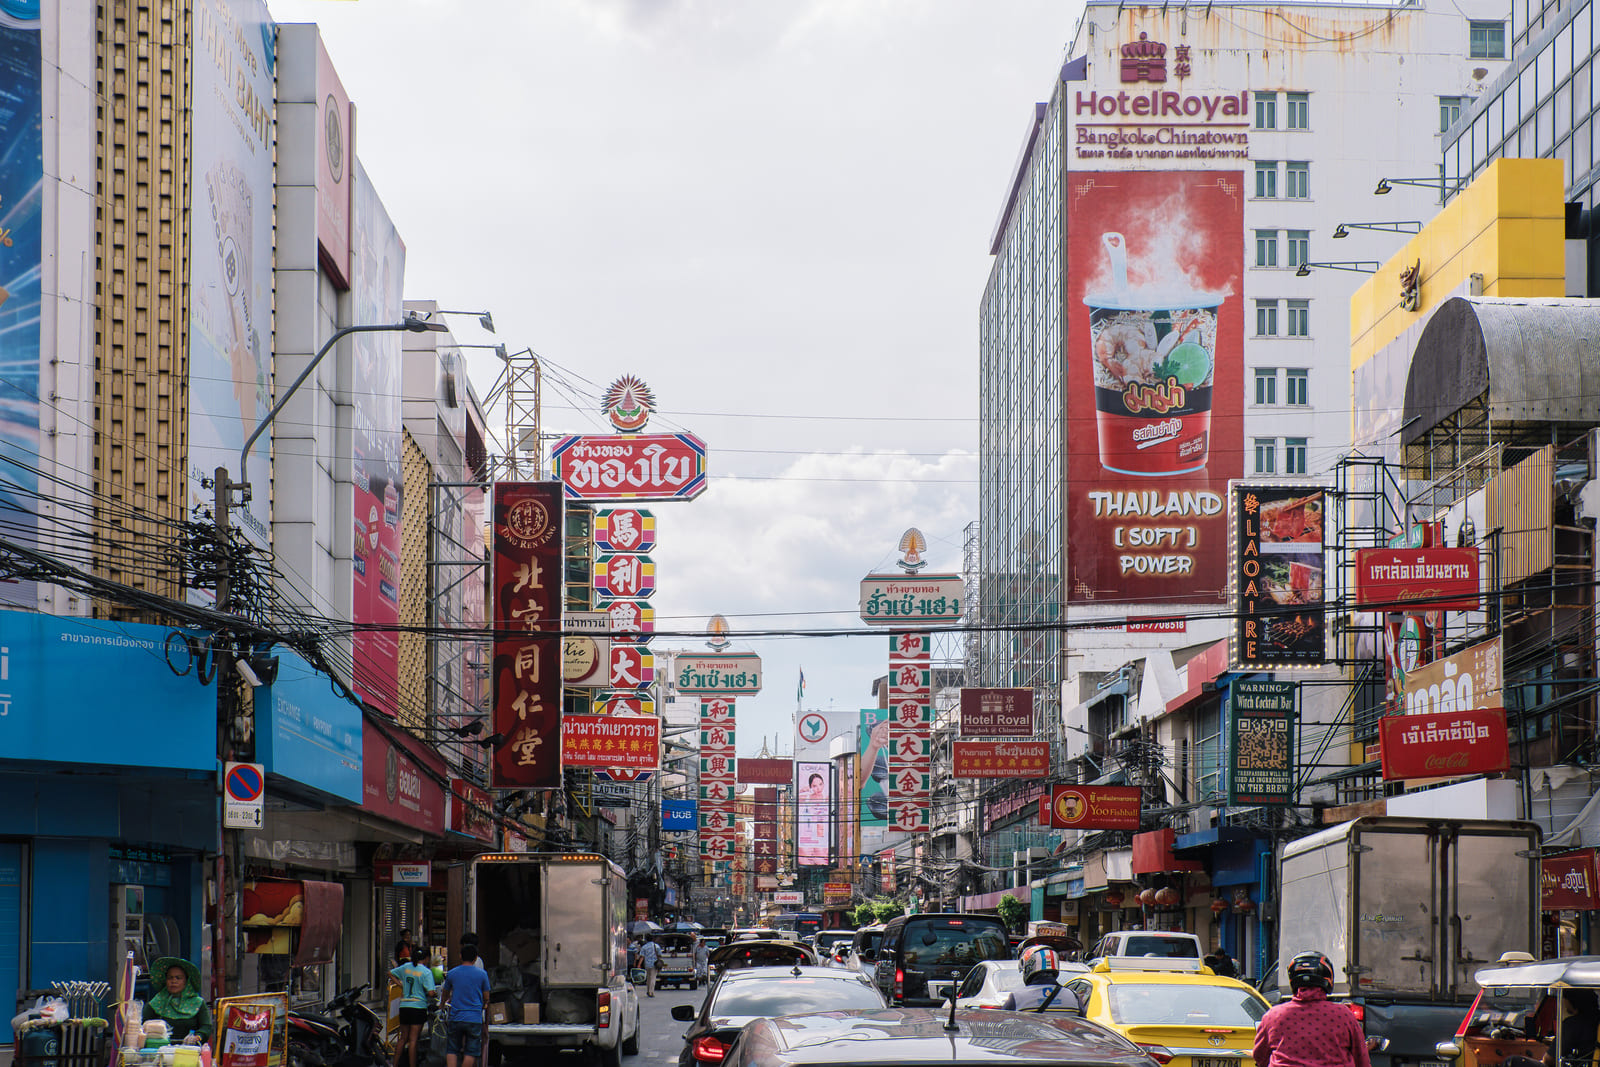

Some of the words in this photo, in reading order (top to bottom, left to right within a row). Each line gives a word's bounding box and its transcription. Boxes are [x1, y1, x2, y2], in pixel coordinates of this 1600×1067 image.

[1123, 376, 1186, 414] มาม่า
[571, 440, 633, 458] ห้างทอง
[569, 443, 691, 489] ทองใบ
[1088, 491, 1222, 517] THAILAND
[1119, 555, 1193, 575] POWER
[886, 584, 940, 594] ห้างขายทอง
[866, 588, 960, 616] ฮั่วเซ่งเฮง
[511, 555, 544, 766] 北京同仁堂
[695, 661, 738, 669] ห้างขายทอง
[679, 664, 759, 688] ฮั่วเซ่งเฮง
[1239, 684, 1282, 692] WARNING
[1237, 695, 1254, 708] Witch
[1255, 695, 1279, 709] Cocktail
[1280, 696, 1293, 709] Bar
[897, 633, 921, 827] 和成興大金行
[963, 714, 994, 725] Hotel
[996, 714, 1030, 726] Royal
[708, 702, 729, 858] 和成興大金行
[1237, 784, 1245, 793] IN
[1248, 784, 1263, 793] THE
[1266, 784, 1289, 793] BREW
[672, 810, 693, 819] UOB
